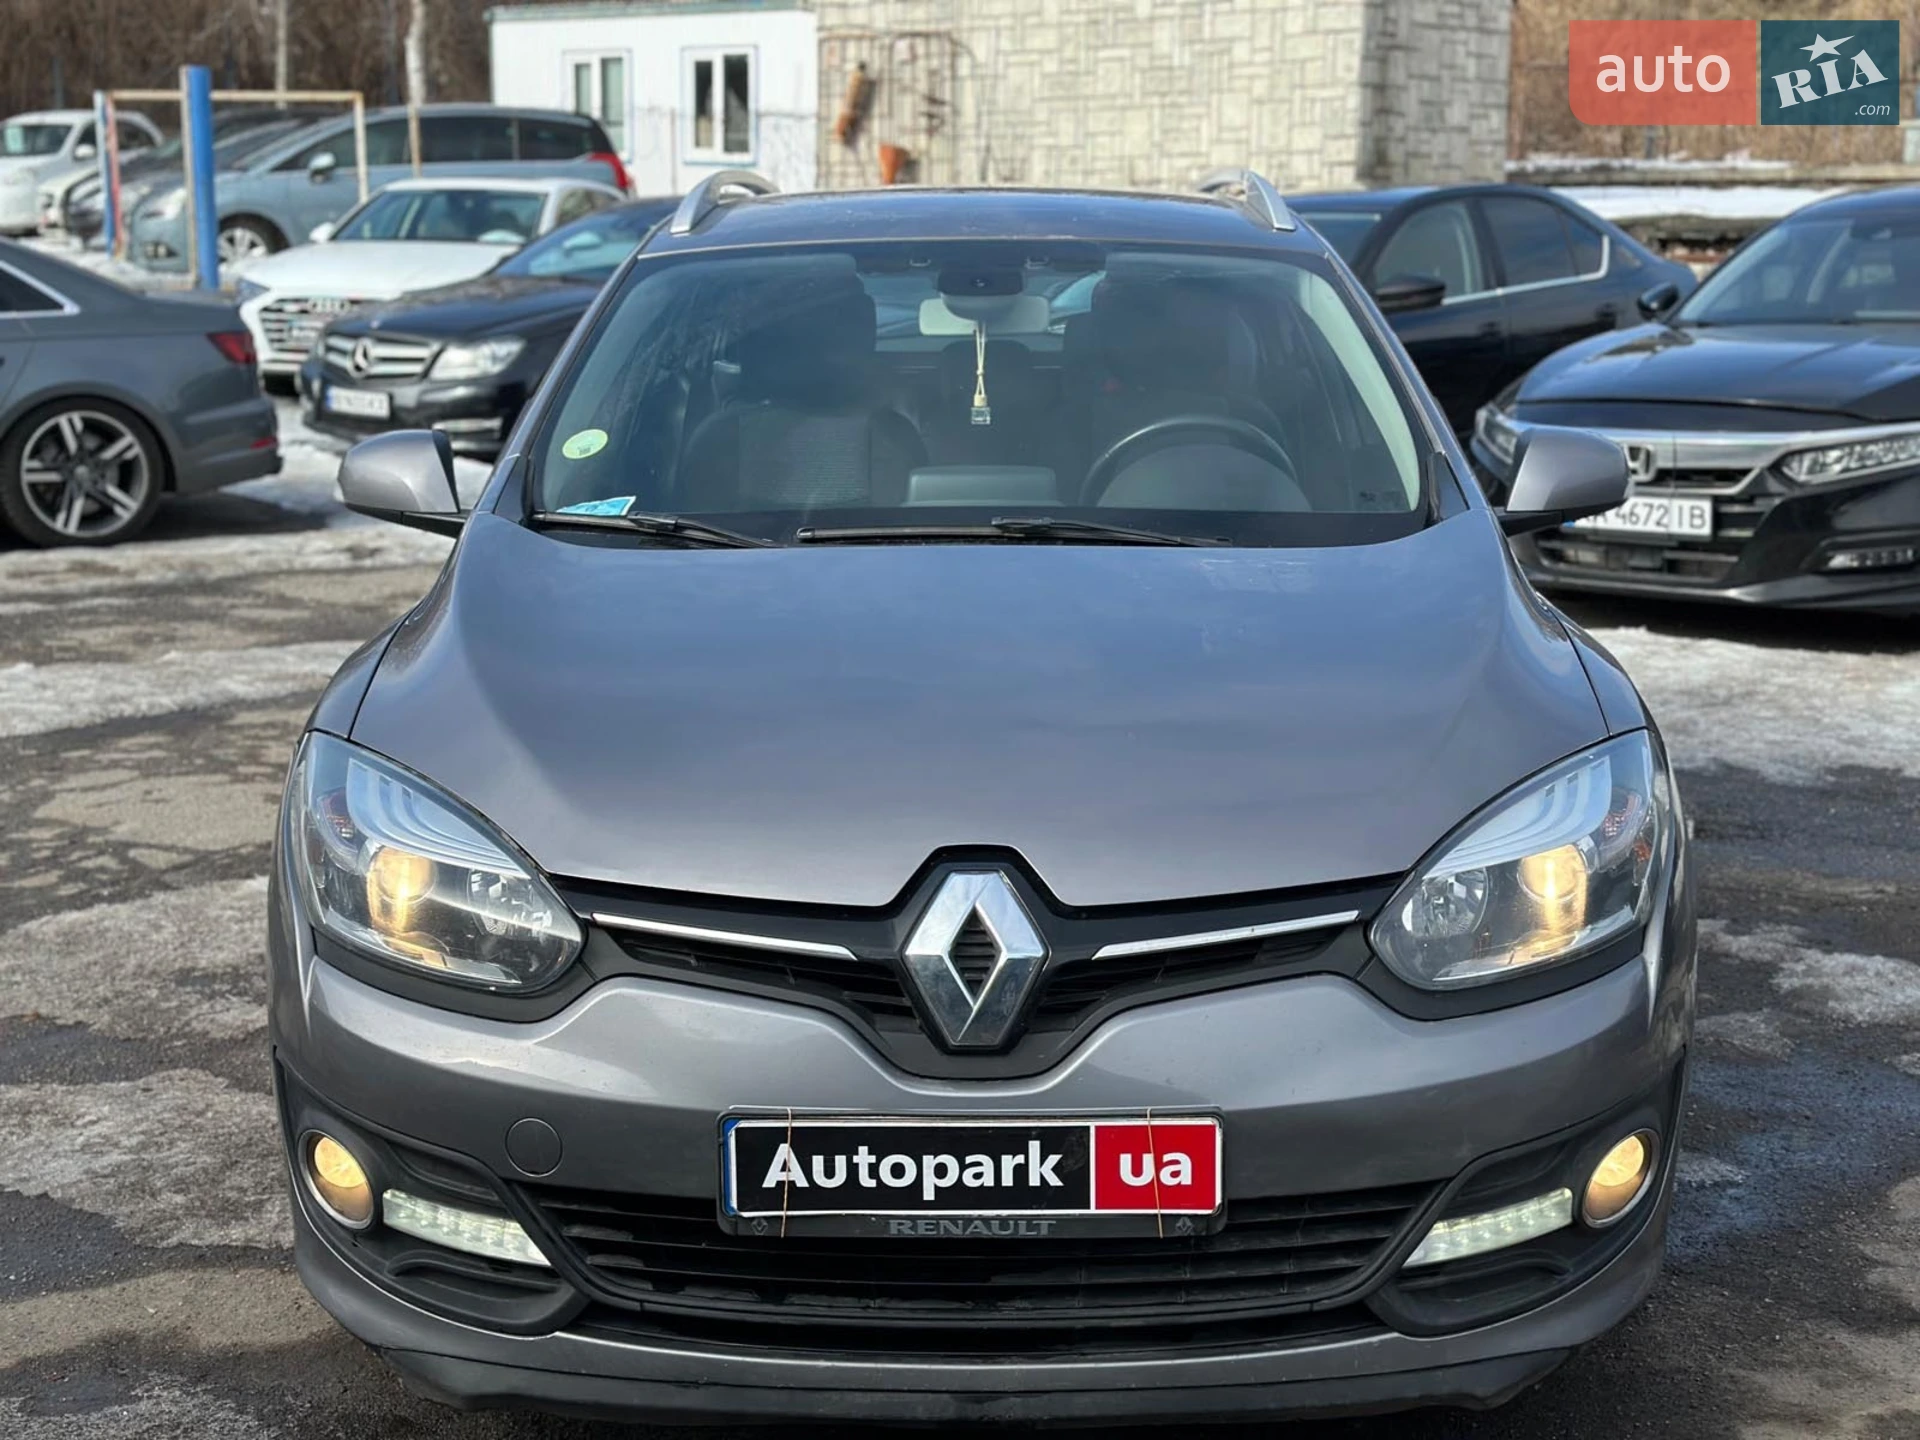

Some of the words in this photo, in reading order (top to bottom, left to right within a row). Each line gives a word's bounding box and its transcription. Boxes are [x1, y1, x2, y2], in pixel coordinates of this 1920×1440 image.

[762, 1141, 1064, 1201] Autopark
[1119, 1151, 1192, 1186] ua
[888, 1219, 1057, 1237] RENAULT
